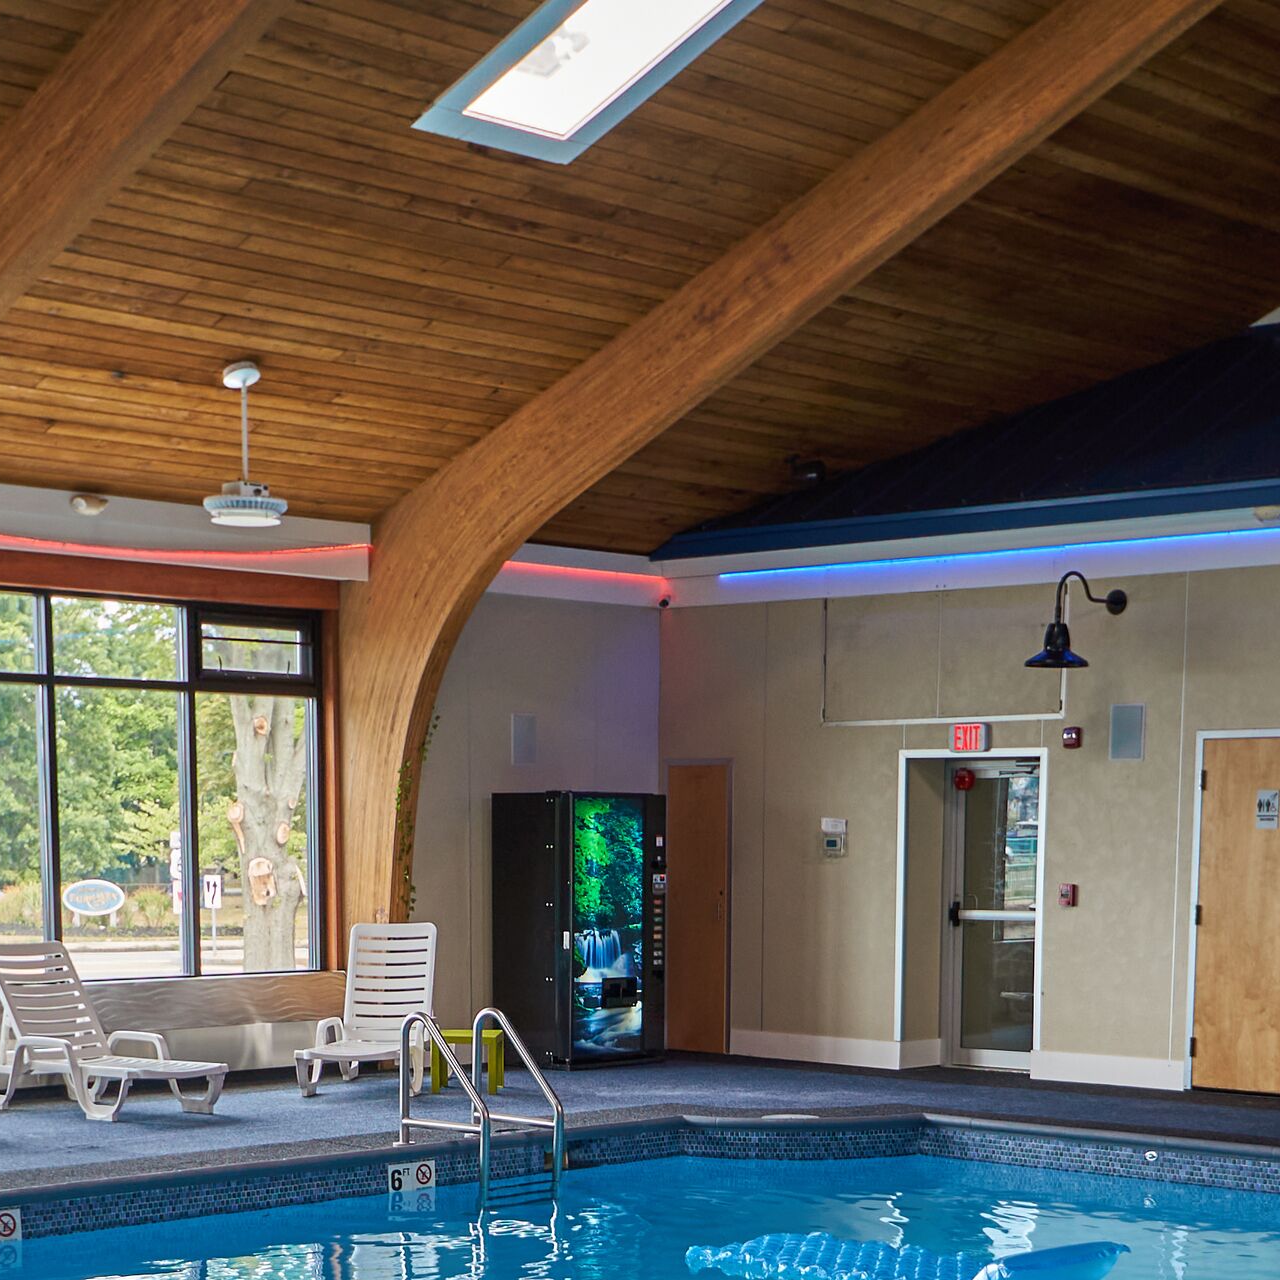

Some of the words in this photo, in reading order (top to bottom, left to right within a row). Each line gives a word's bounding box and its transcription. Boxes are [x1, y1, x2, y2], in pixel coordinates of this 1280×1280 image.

[954, 724, 980, 750] EXIT
[391, 1169, 402, 1191] 6
[403, 1168, 410, 1176] FT
